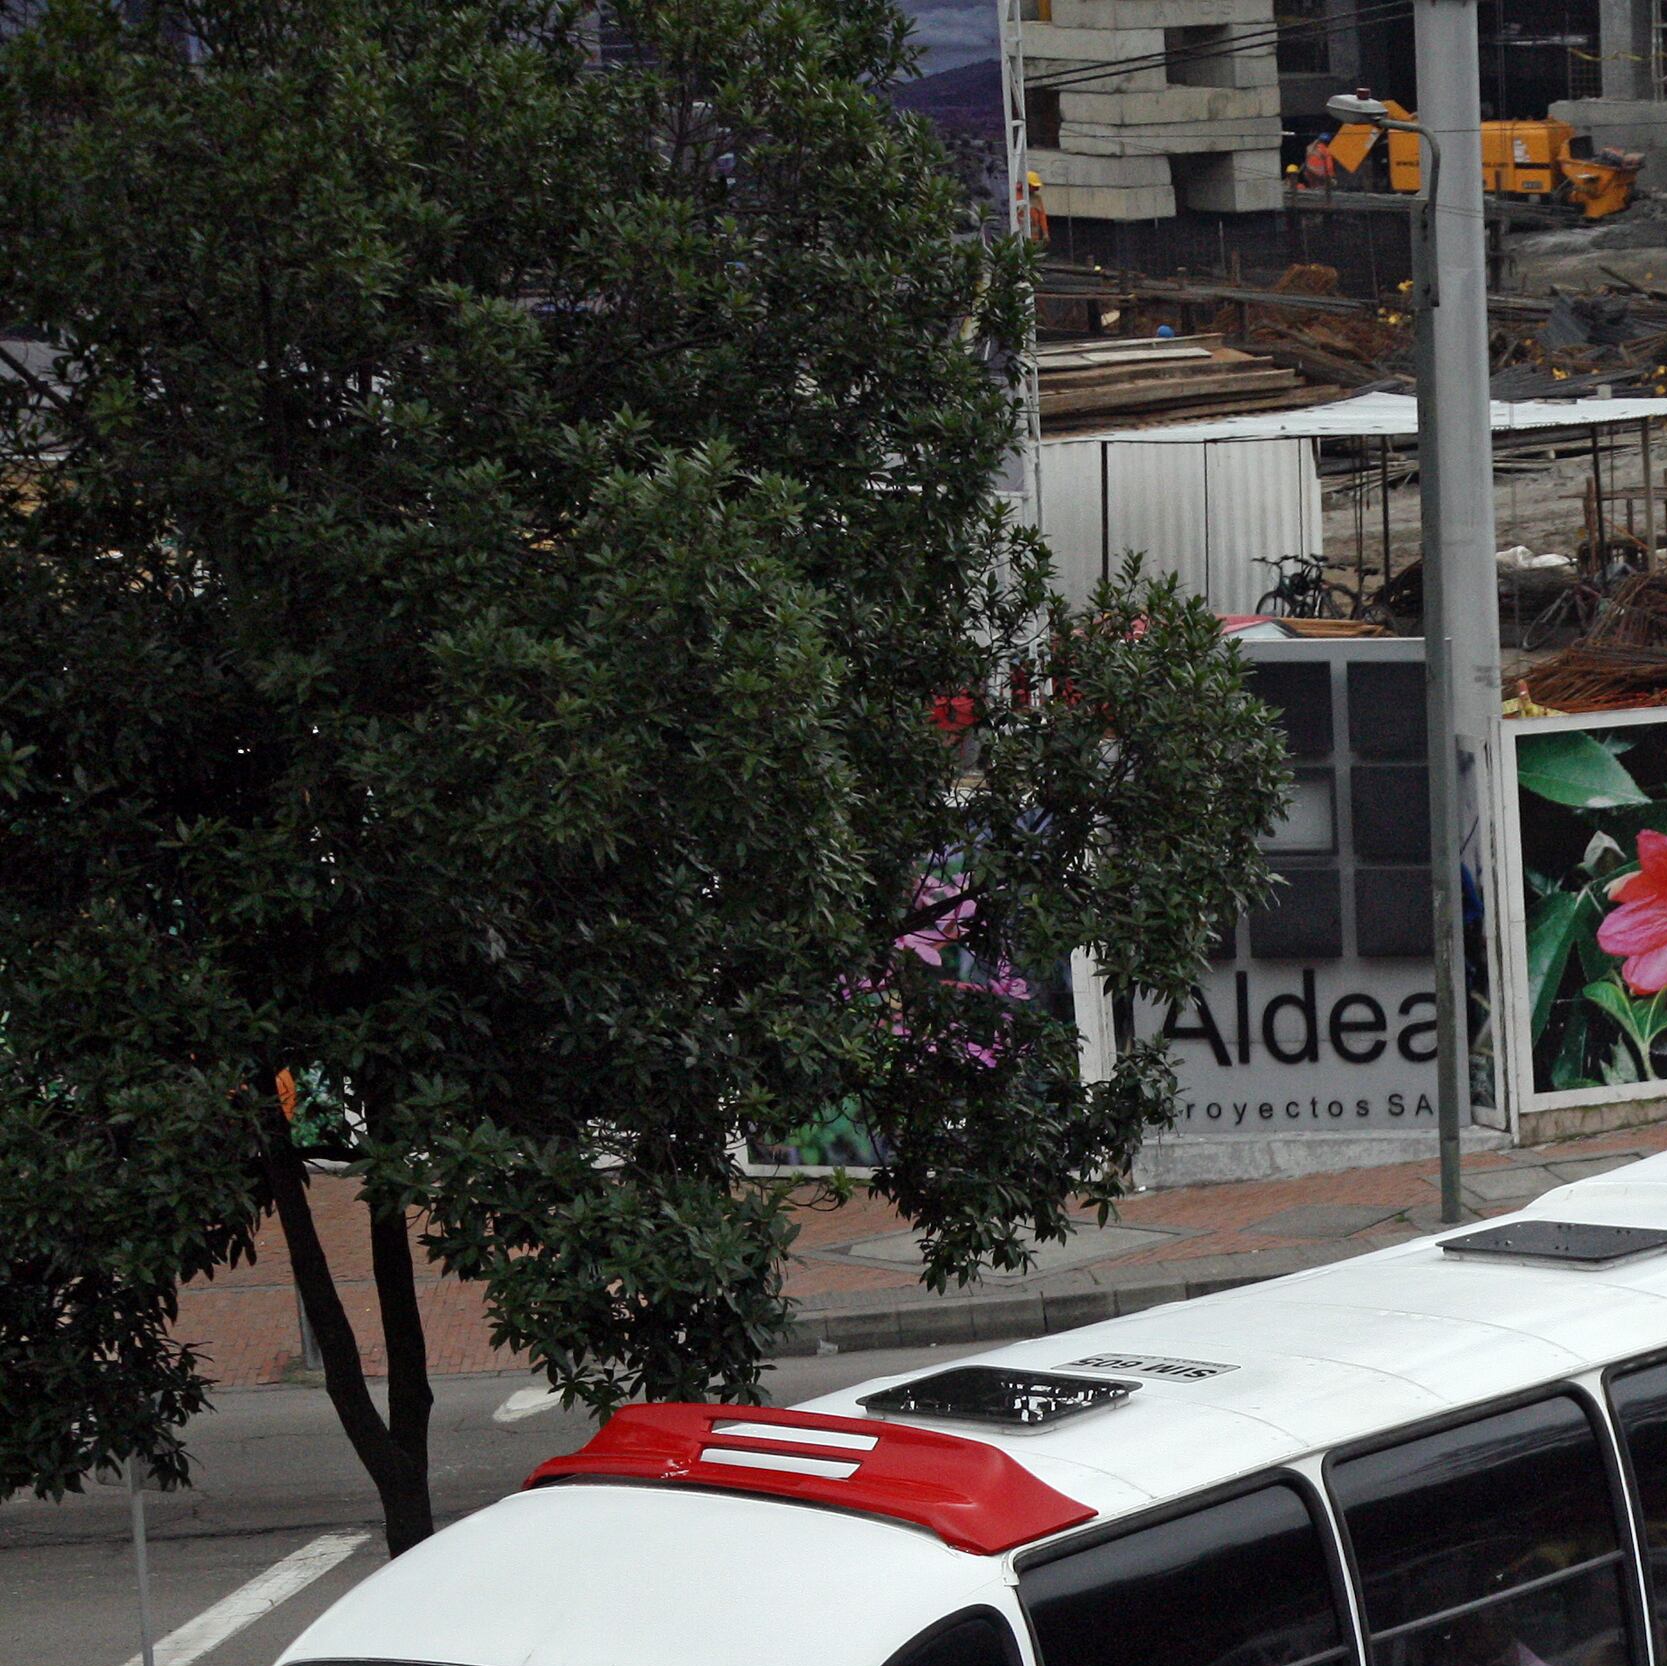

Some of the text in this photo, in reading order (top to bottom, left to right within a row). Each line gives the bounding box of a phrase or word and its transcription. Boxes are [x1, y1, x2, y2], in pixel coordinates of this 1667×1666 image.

[1162, 967, 1437, 1067] Aldea
[1072, 1358, 1136, 1371] 605
[1141, 1361, 1218, 1378] SIM
